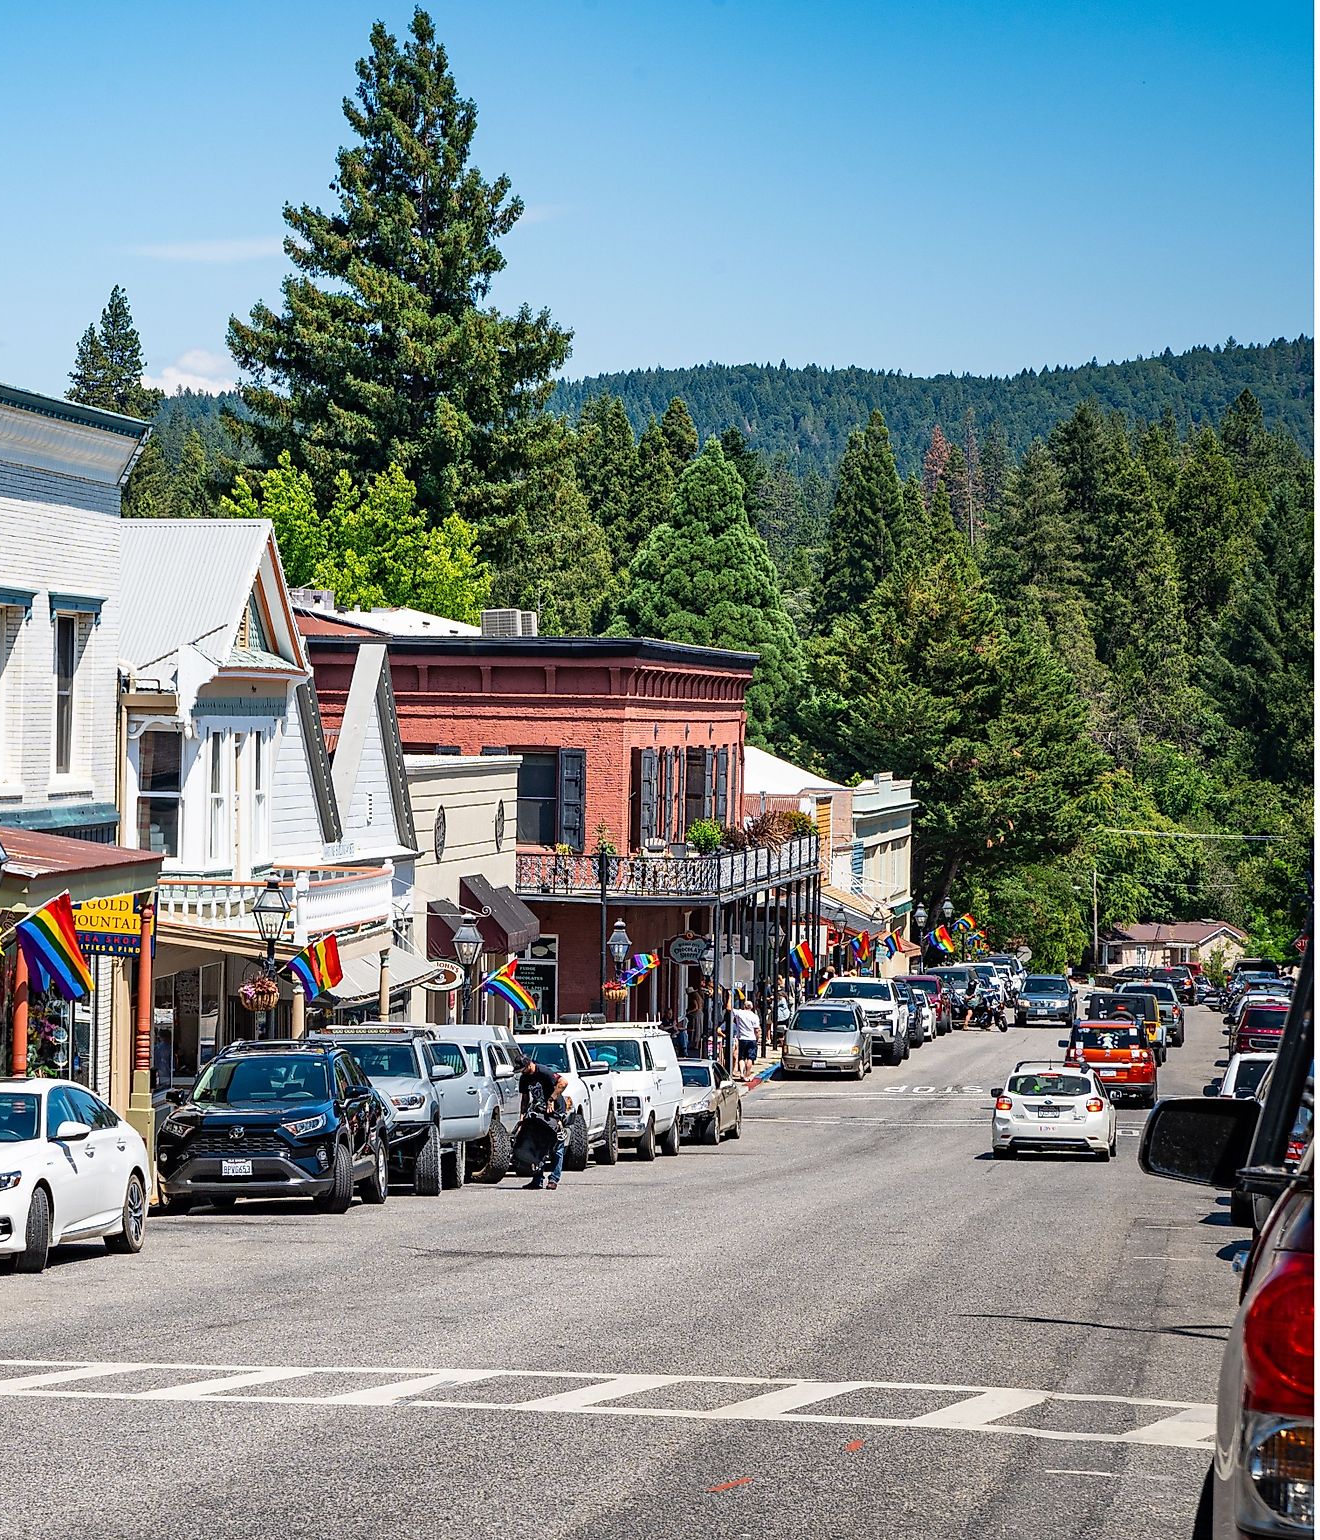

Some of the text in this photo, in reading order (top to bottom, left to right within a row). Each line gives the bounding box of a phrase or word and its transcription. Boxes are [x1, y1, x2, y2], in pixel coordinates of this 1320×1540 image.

[86, 899, 129, 912] GOLD
[73, 914, 142, 930] OUNTAI
[76, 933, 137, 945] TEA SHOP
[80, 943, 106, 952] ITIES
[118, 946, 141, 954] FIND
[883, 1085, 984, 1094] STOP
